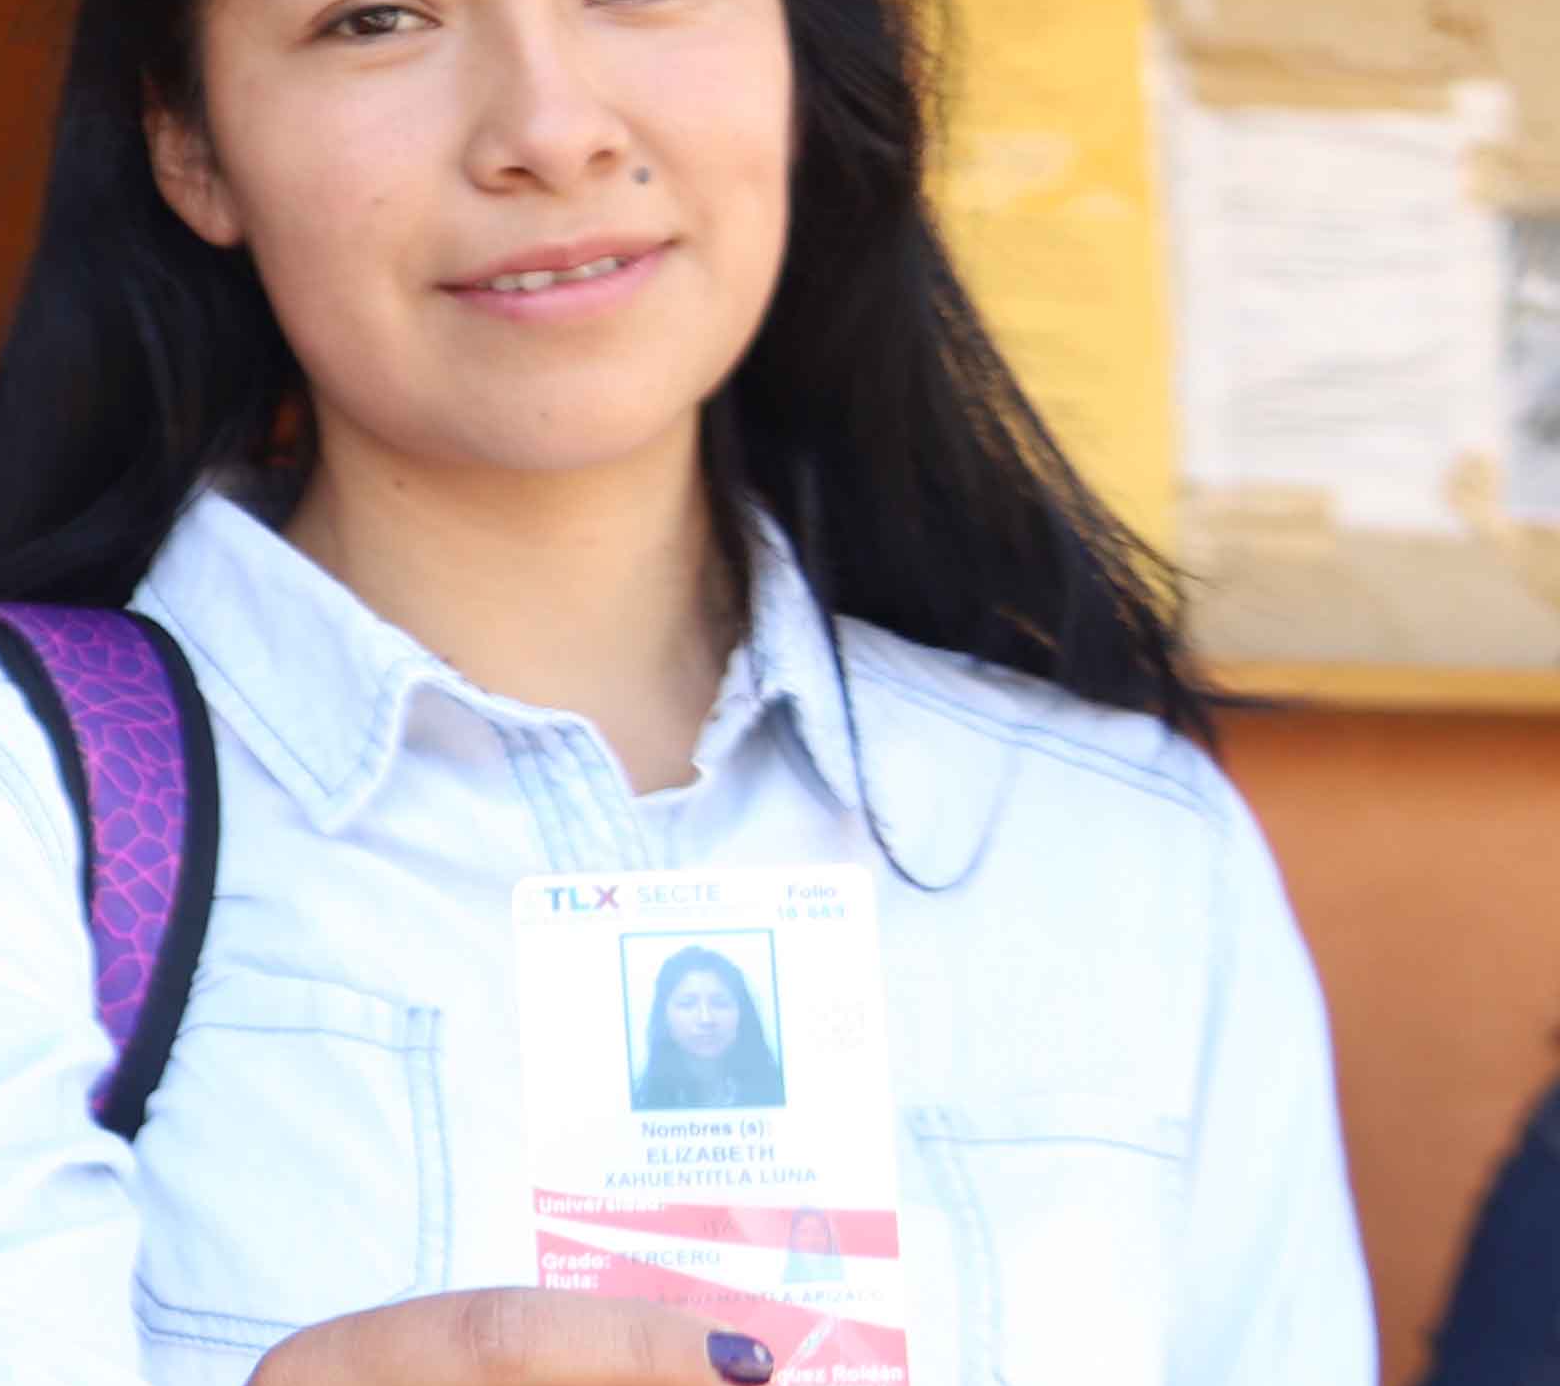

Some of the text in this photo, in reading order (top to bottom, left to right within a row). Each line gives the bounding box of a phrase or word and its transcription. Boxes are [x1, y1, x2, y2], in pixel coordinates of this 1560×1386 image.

[543, 883, 721, 912] TLX SECTE
[640, 1120, 733, 1139] Nombres
[645, 1144, 776, 1165] ELIZABETH
[760, 1167, 818, 1186] LUNA
[542, 1253, 611, 1271] Grado:
[546, 1272, 598, 1290] Ruta:
